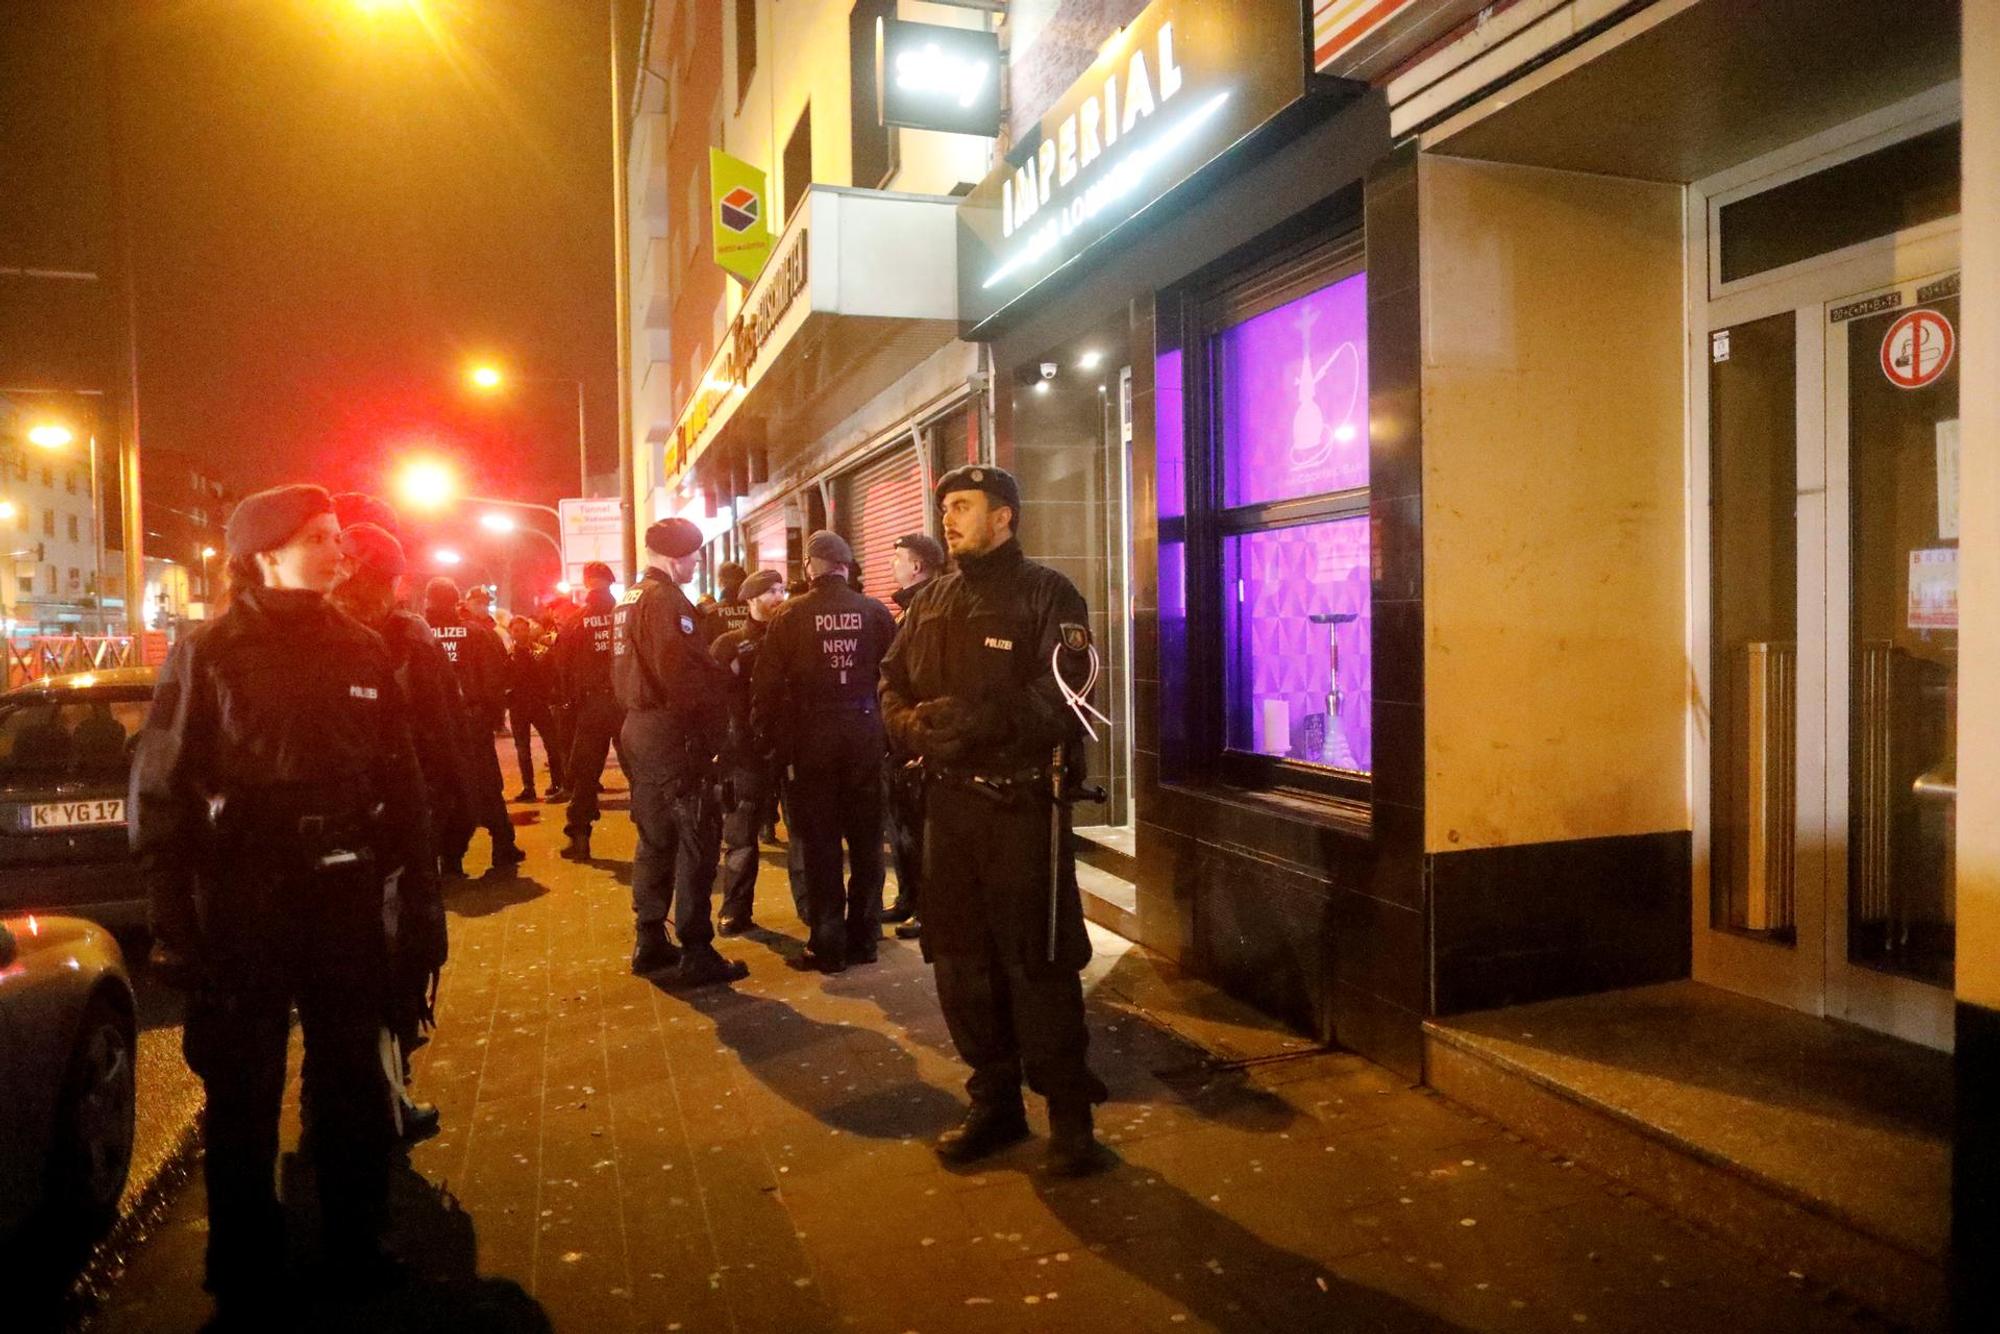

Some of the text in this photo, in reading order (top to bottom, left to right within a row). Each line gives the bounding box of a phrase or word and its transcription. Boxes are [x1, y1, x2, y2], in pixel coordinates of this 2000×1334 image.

[1002, 20, 1182, 238] IMPERIAL
[718, 606, 750, 616] POLIZ
[815, 613, 862, 631] POLIZEI
[823, 639, 858, 654] NRW
[985, 637, 1012, 650] POLIZEI
[831, 656, 853, 668] 314
[350, 686, 377, 699] POLIZEI
[34, 802, 119, 825] K YG 17
